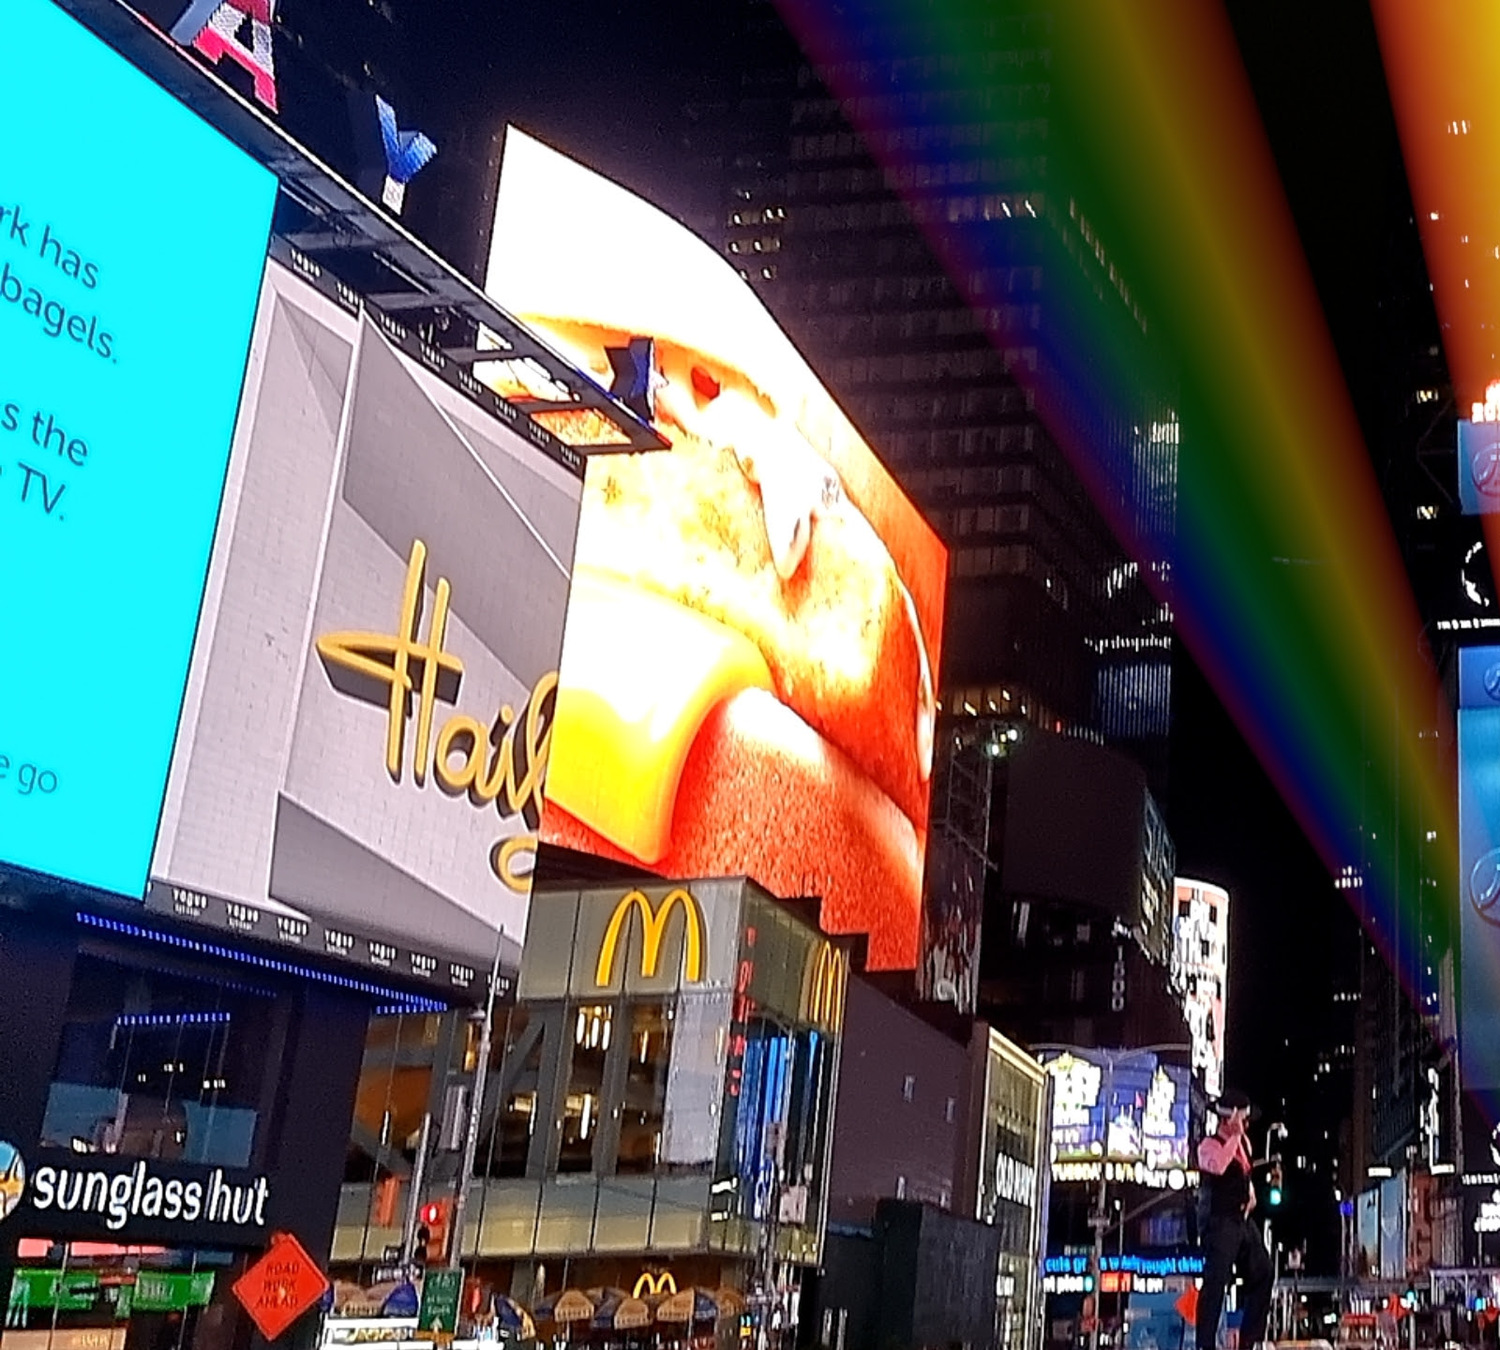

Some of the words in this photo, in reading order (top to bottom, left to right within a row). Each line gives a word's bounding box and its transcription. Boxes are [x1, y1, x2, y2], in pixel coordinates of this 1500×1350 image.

[40, 224, 99, 289] has
[0, 262, 117, 364] bagels.
[32, 411, 88, 466] the
[18, 462, 66, 522] TV.
[18, 763, 58, 795] go
[33, 1160, 203, 1229] sunglass
[208, 1168, 270, 1226] hut
